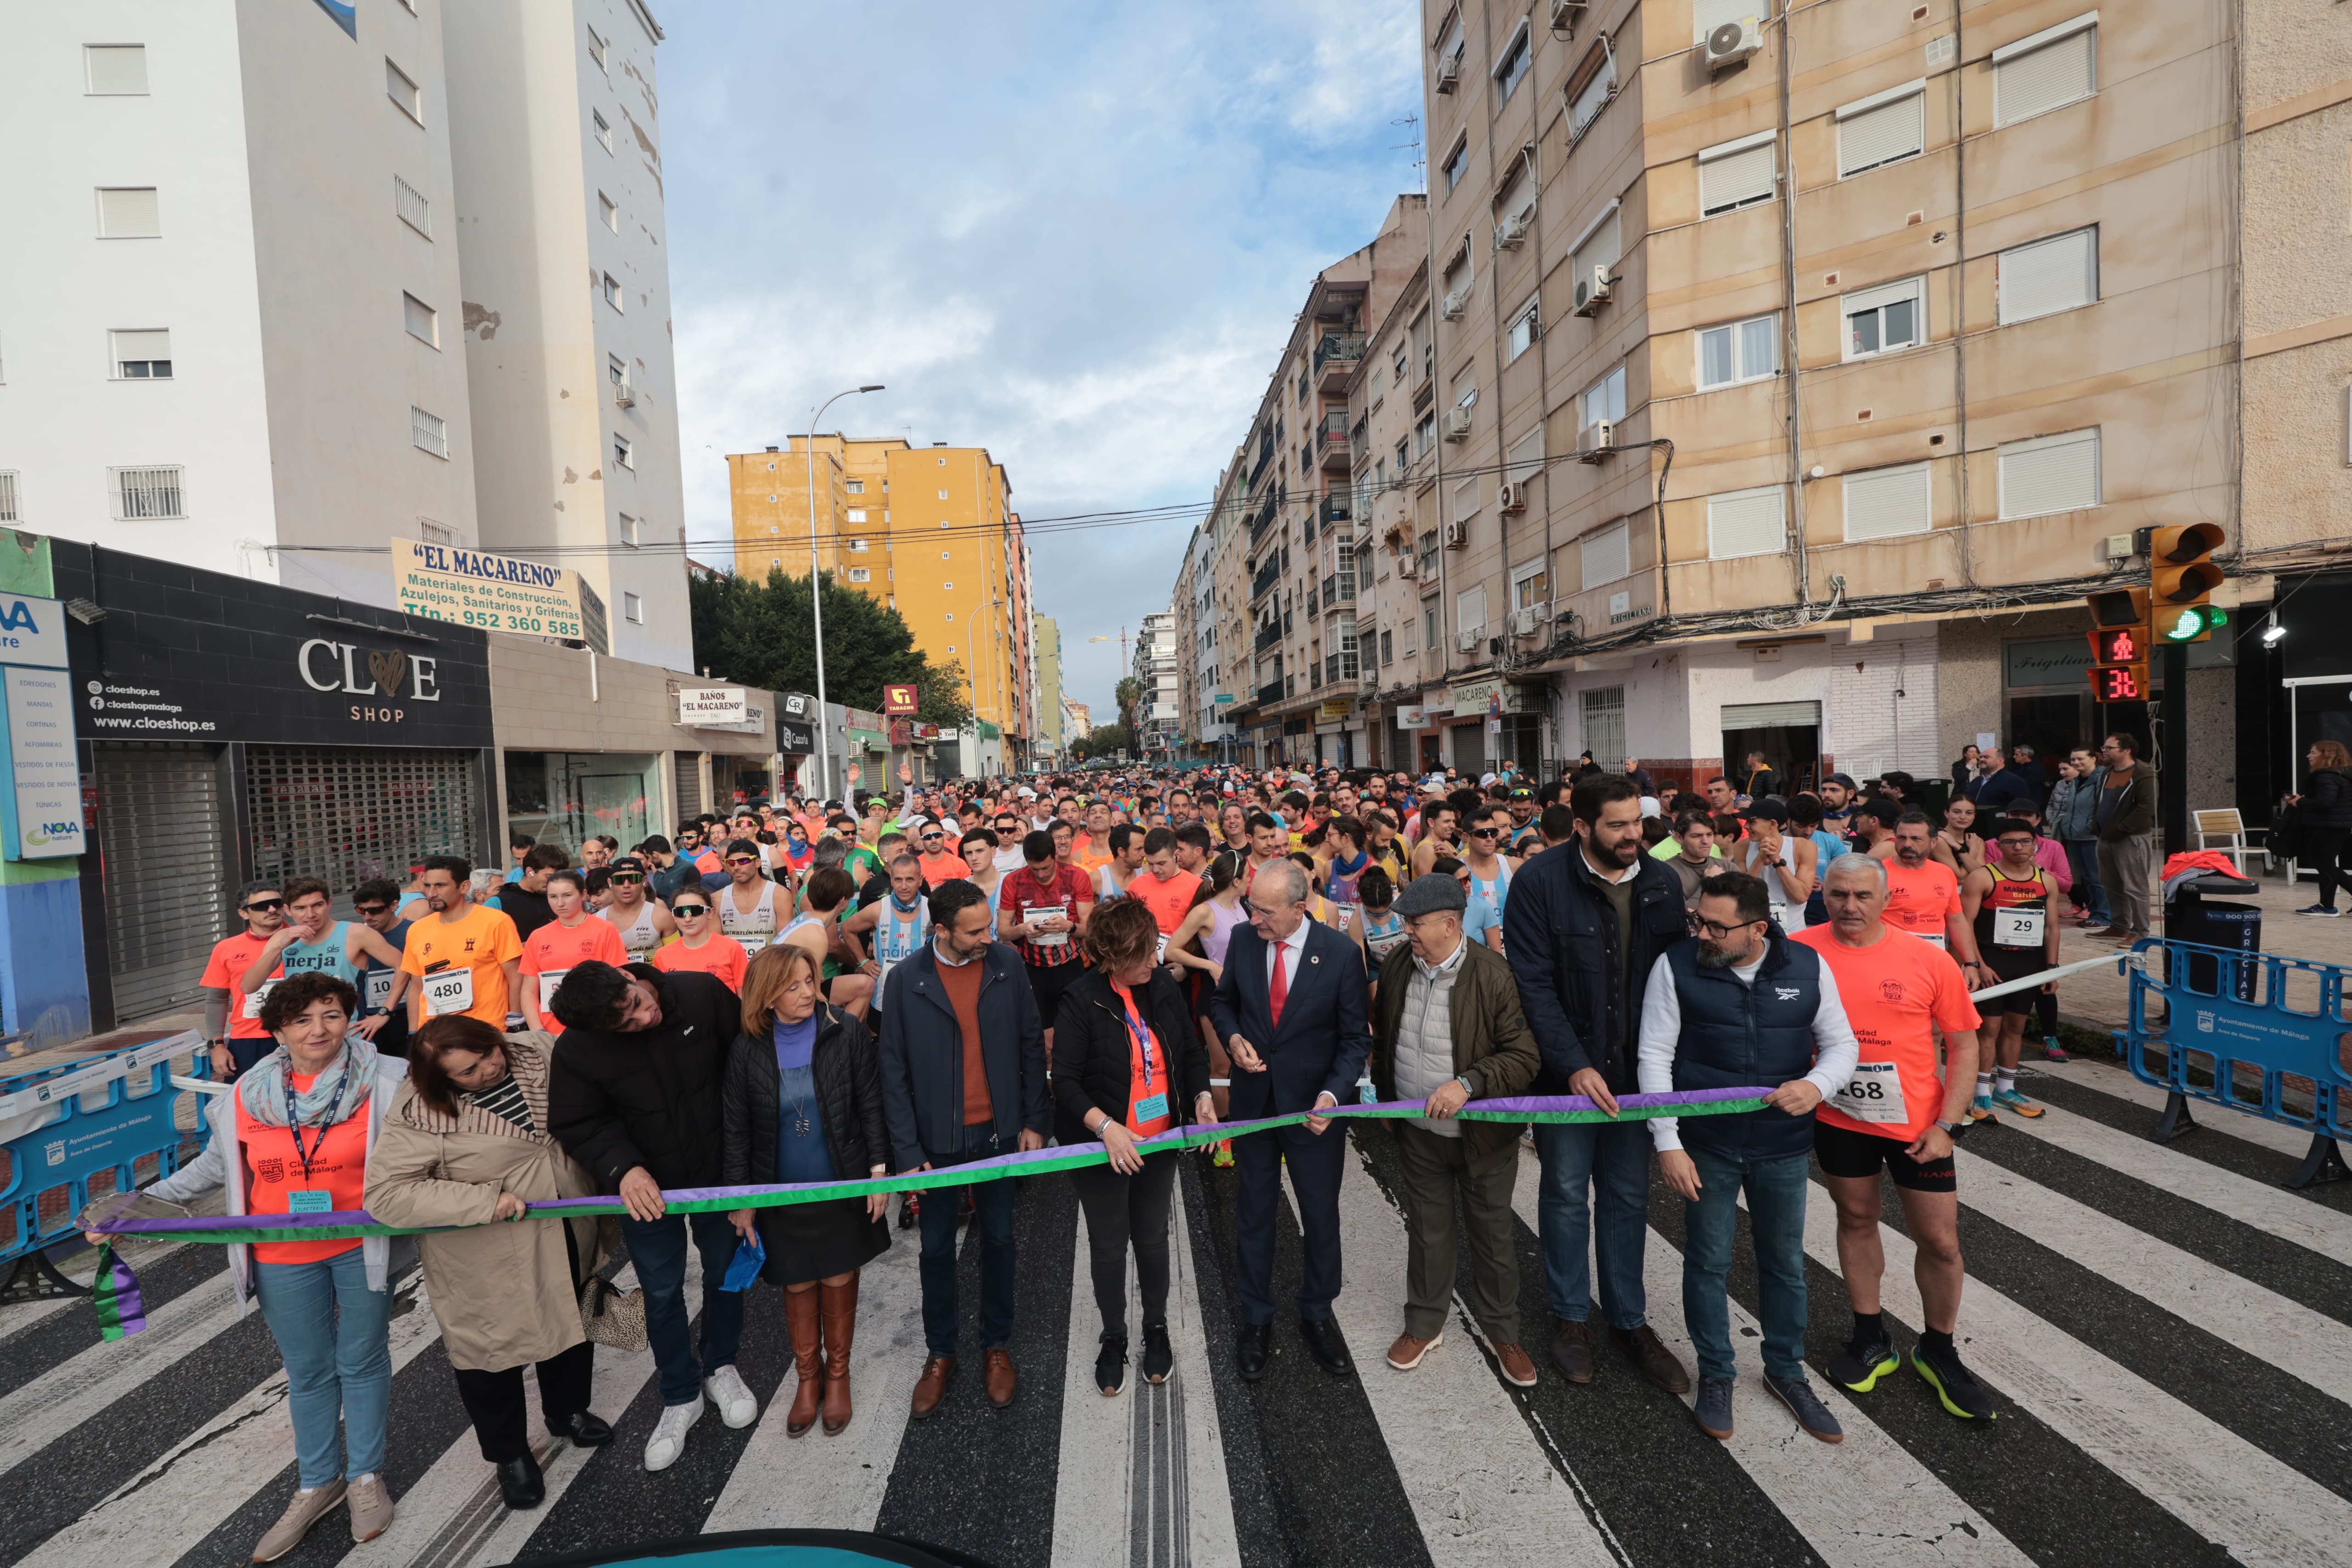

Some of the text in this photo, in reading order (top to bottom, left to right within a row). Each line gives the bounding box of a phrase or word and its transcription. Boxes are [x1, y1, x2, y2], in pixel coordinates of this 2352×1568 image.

[407, 573, 571, 609] Materiales de Construcción,
[400, 587, 580, 621] Azulejos, Sanitarios y Griferías
[463, 610, 500, 628] 952
[507, 616, 541, 632] 360
[548, 620, 580, 636] 585
[0, 636, 20, 648] re
[2014, 655, 2097, 672] Frigilian
[20, 680, 57, 688] EDREDONES
[105, 685, 160, 696] cloeshop.es
[700, 691, 725, 700] BAÑOS
[1456, 685, 1493, 703] MACARENO
[106, 701, 182, 713] cloeshopmalaga
[350, 705, 404, 723] SHOP
[93, 716, 216, 733] www.cloeshop.es
[792, 733, 808, 745] Cazorla
[43, 821, 79, 836] NOVA
[2013, 920, 2032, 932] 29
[285, 953, 336, 970] nerja
[434, 982, 463, 999] 480
[2217, 1016, 2267, 1032] Ayuntamiento
[2281, 1029, 2310, 1041] Málaga
[1858, 1037, 1892, 1046] Málaga
[2239, 1032, 2261, 1042] Deporte
[334, 1087, 344, 1101] SUR
[325, 1109, 335, 1123] SUR
[68, 1114, 152, 1146] Ayuntamiento de Málaga
[316, 1132, 325, 1145] SUR
[69, 1148, 83, 1158] Área
[91, 1139, 113, 1150] Deporte
[308, 1165, 343, 1174] Málaga
